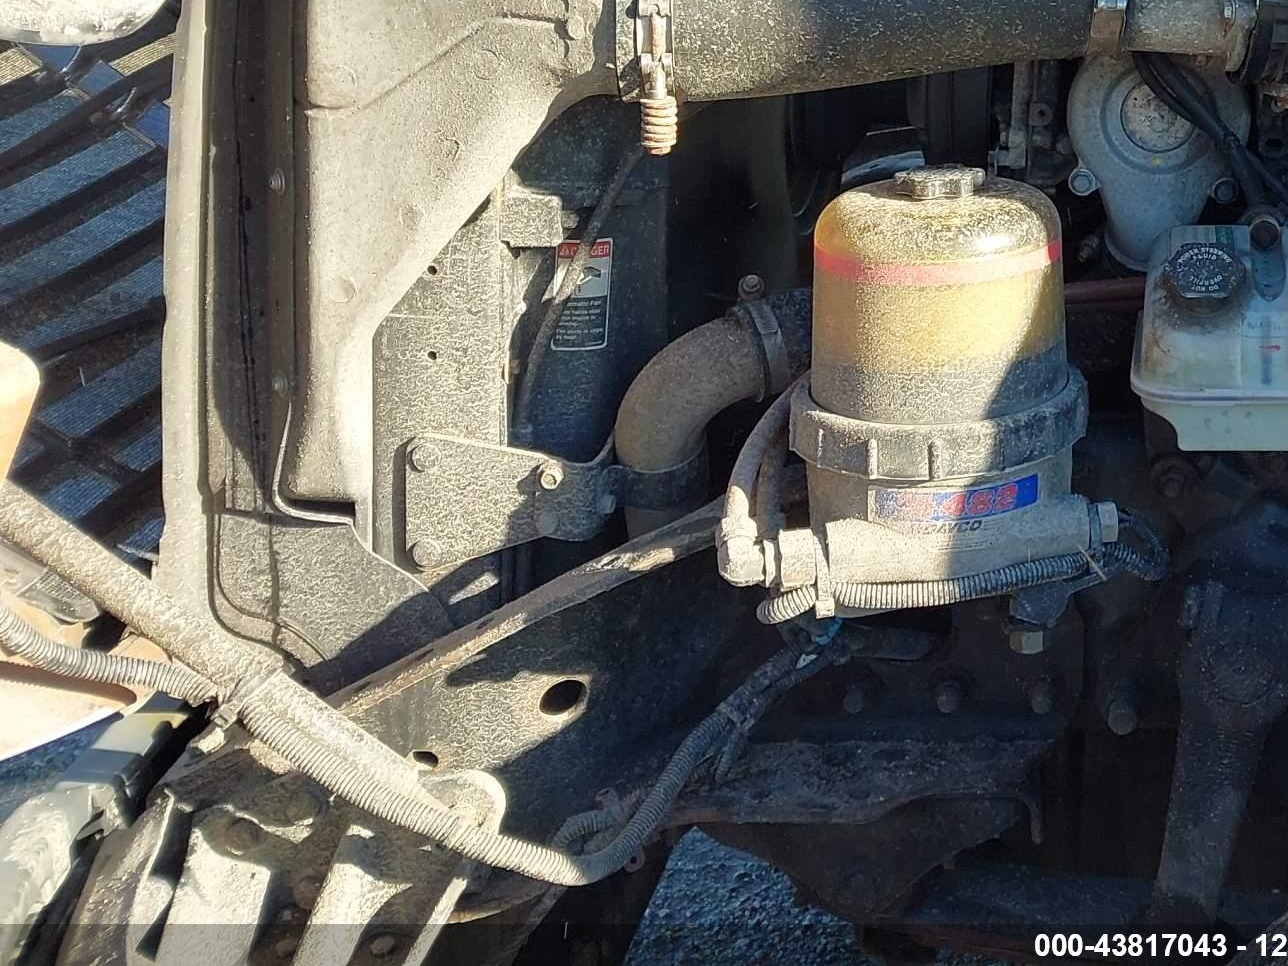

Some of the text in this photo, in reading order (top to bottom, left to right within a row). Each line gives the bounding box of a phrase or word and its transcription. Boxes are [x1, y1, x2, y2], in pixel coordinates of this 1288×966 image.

[570, 245, 609, 256] DGER
[1177, 247, 1233, 264] POWER STEERING
[1191, 252, 1218, 261] FLUID
[1188, 274, 1224, 286] OVERFILL
[1191, 284, 1220, 292] DO NOT
[940, 482, 1019, 517] 482
